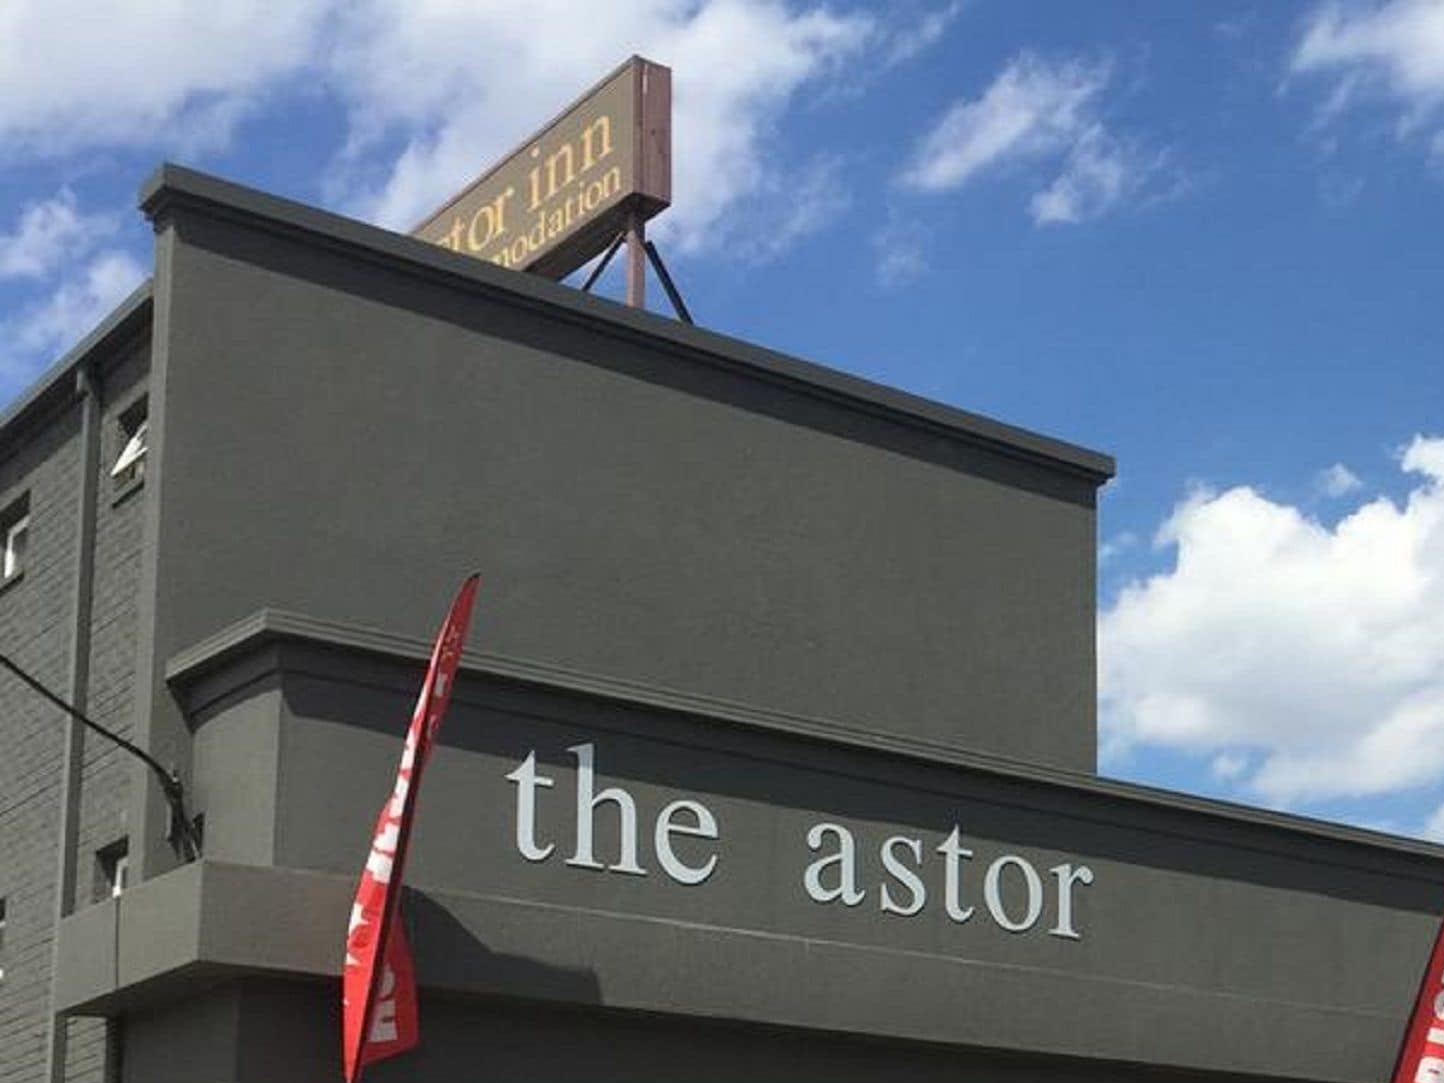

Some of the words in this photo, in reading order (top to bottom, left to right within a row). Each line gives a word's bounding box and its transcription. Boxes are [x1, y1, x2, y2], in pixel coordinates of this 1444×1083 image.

[436, 187, 515, 252] tor
[527, 115, 612, 212] inn
[505, 743, 720, 885] the
[803, 824, 1094, 937] astor
